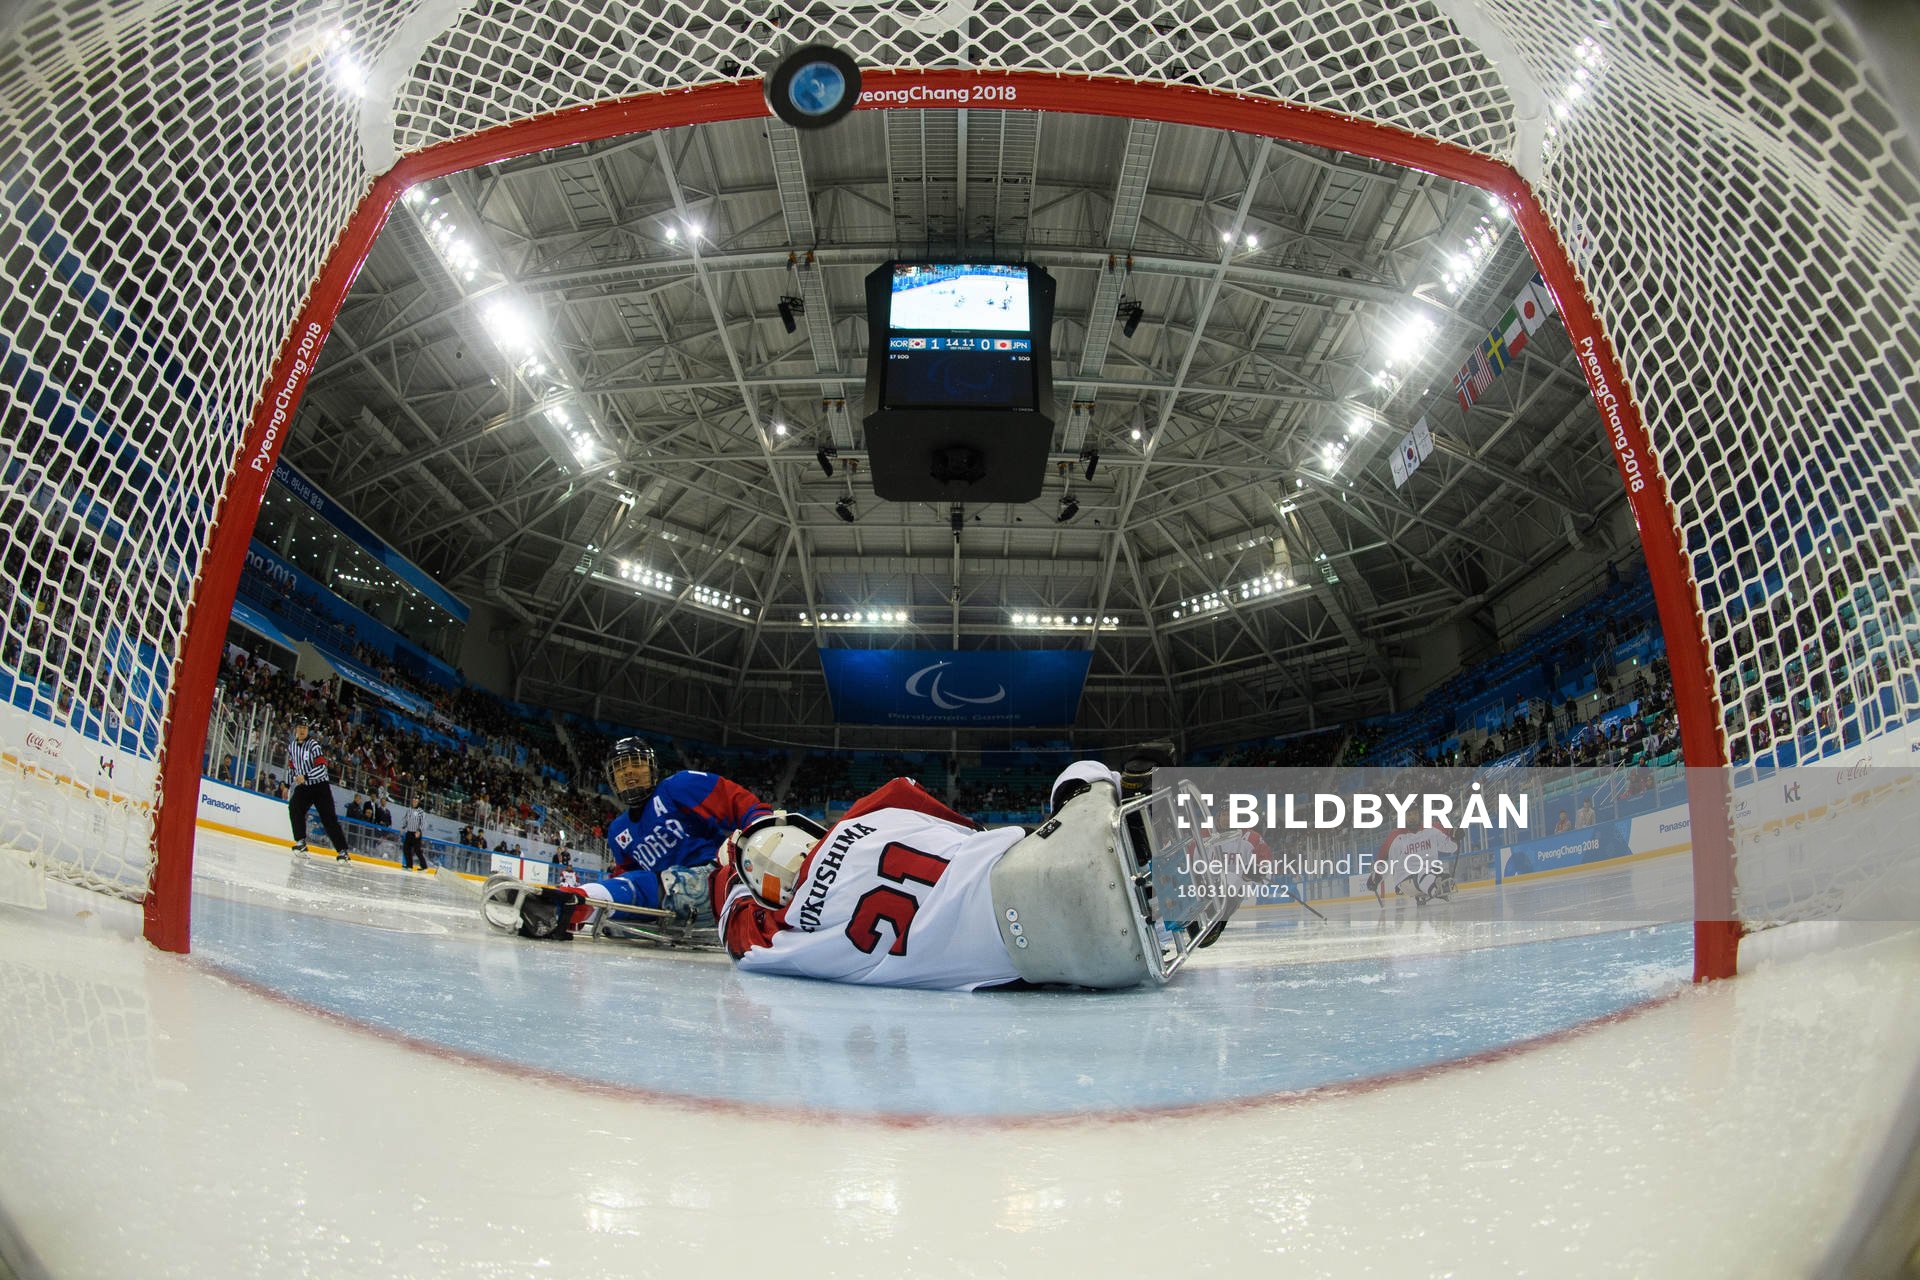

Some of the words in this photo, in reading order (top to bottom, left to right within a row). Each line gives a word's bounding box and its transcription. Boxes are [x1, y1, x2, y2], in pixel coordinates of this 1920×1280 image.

[854, 85, 969, 105] yeongChang
[972, 85, 1017, 101] 2018
[890, 339, 908, 348] KOR
[930, 338, 940, 350] 1
[980, 339, 991, 351] 0
[1012, 341, 1028, 350] JPN
[250, 358, 306, 473] PyeongChang
[297, 321, 322, 360] 2018
[1580, 335, 1628, 451] PyeongChang
[1621, 448, 1645, 493] 2018
[887, 712, 968, 722] Paralympic
[972, 712, 1021, 721] Games
[1783, 780, 1801, 804] kt
[201, 793, 241, 814] Panasonic
[652, 795, 669, 817] A
[632, 818, 691, 872] KOREA
[1404, 839, 1432, 856] JAPAN
[1537, 844, 1583, 862] PyeongChang
[1582, 839, 1600, 851] 2018
[844, 841, 952, 957] 21
